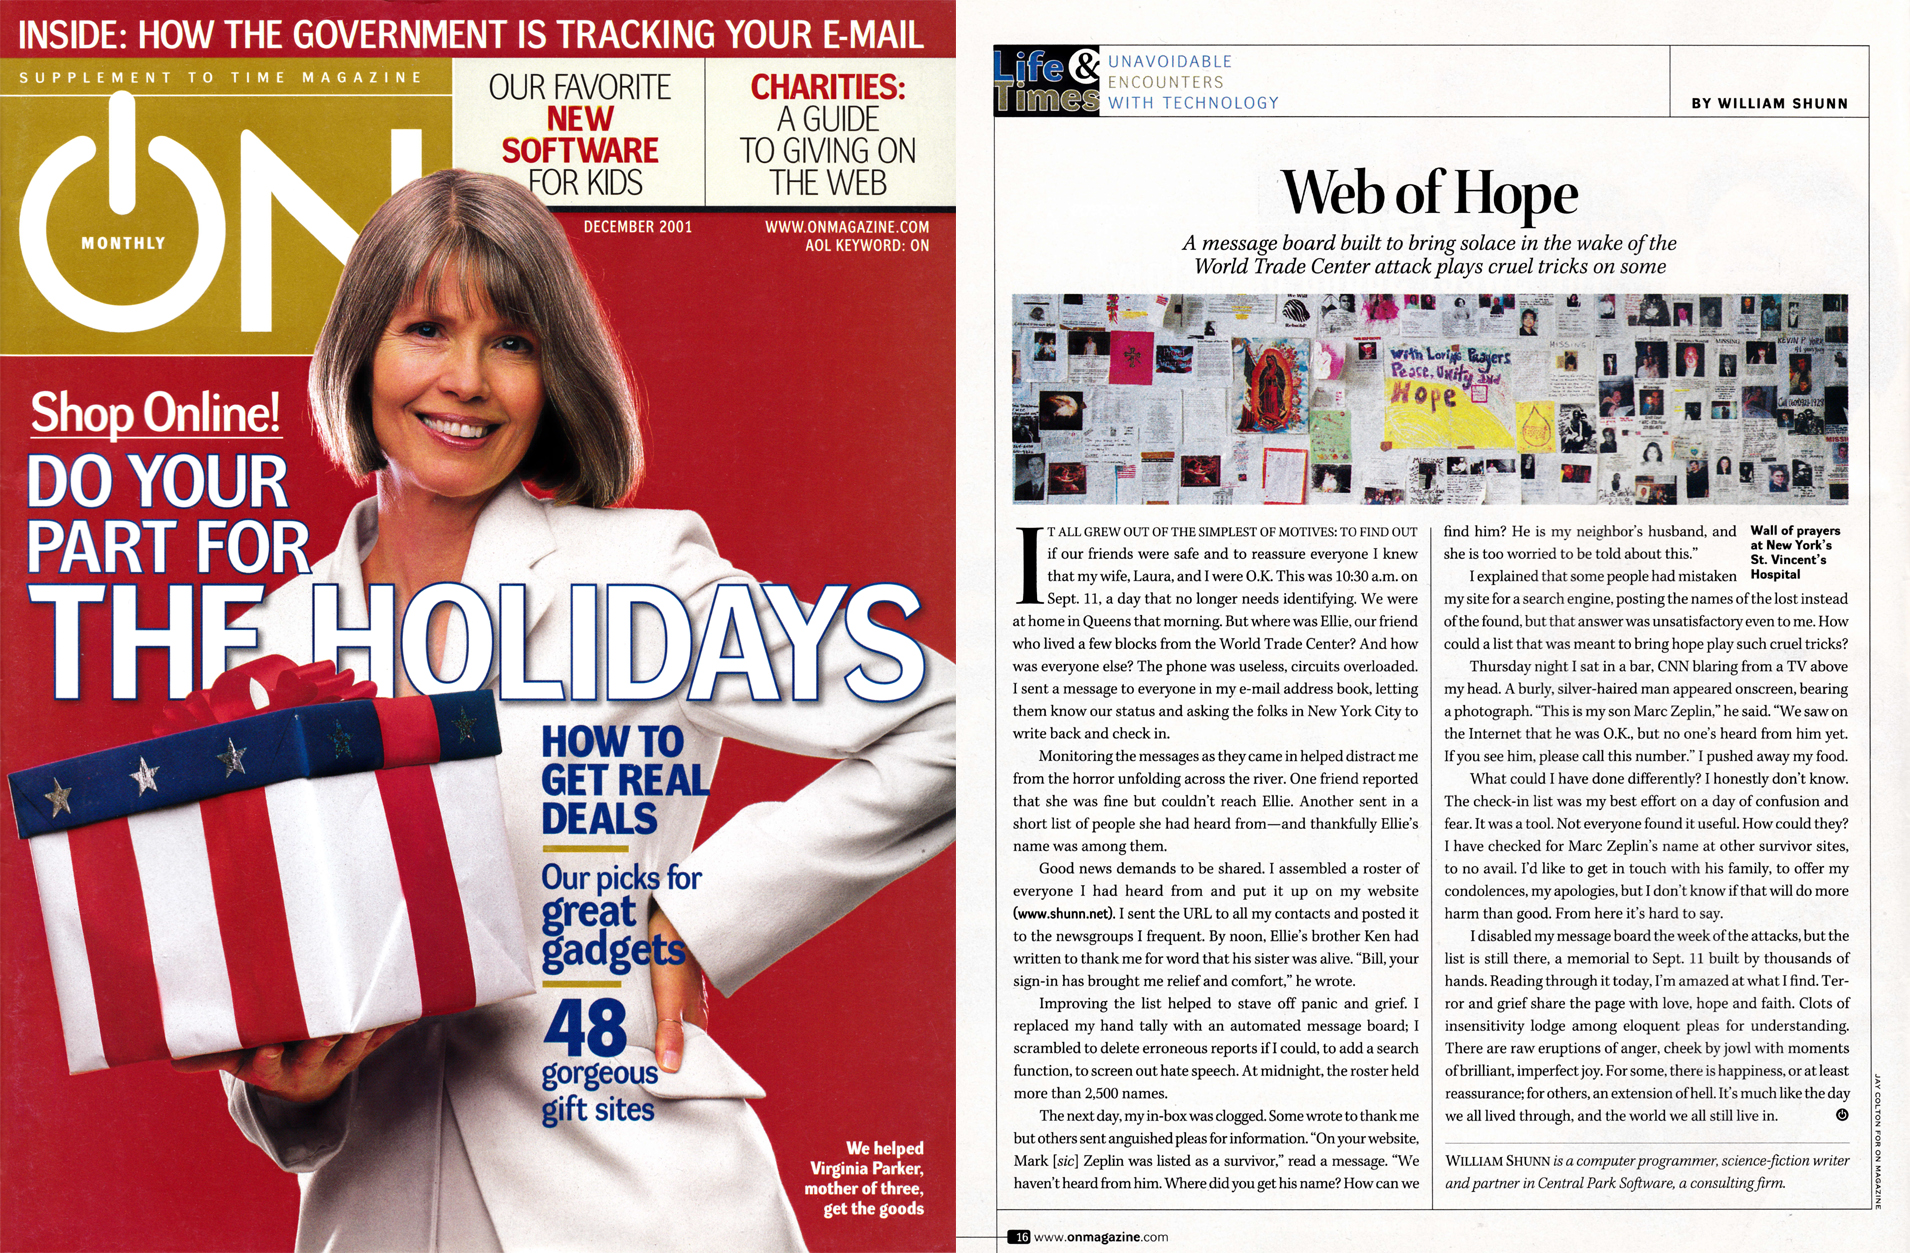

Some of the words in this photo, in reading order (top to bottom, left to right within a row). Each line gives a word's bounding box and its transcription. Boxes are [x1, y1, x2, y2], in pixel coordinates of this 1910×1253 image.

[20, 20, 125, 49] INSIDE:
[140, 20, 214, 49] HOW
[224, 20, 282, 48] THE
[294, 20, 507, 48] GOVERNMENT
[519, 20, 545, 48] IS
[557, 20, 714, 48] TRACKING
[725, 20, 812, 48] YOUR
[825, 20, 924, 48] E-MAIL
[994, 49, 1064, 83] Life
[1074, 51, 1100, 79] &
[1109, 55, 1231, 68] UNAVOIDABLE
[20, 72, 170, 83] SUPPLEMENT
[189, 72, 212, 83] TO
[231, 72, 283, 83] TIME
[303, 72, 420, 83] MAGAZINE
[490, 73, 545, 100] OUR
[555, 73, 671, 100] FAVORITE
[751, 73, 905, 100] CHARITIES:
[1109, 76, 1222, 88] ENCOUNTERS
[994, 80, 1100, 111] Times
[1108, 97, 1152, 109] WITH
[1163, 96, 1278, 109] TECHNOLOGY
[1693, 98, 1711, 108] BY
[1718, 98, 1784, 108] WILLIAM
[1793, 98, 1847, 109] SHUNN
[548, 106, 614, 131] NEW
[777, 105, 795, 131] A
[804, 105, 879, 132] GUIDE
[502, 137, 658, 163] SOFTWARE
[740, 137, 774, 163] TO
[784, 137, 868, 164] GIVING
[878, 137, 915, 164] ON
[530, 169, 578, 195] FOR
[588, 169, 643, 195] KIDS
[769, 169, 818, 195] THE
[827, 169, 887, 195] WEB
[1280, 168, 1385, 214] Web
[1396, 167, 1447, 214] of
[1455, 170, 1578, 228] Hope
[18, 89, 422, 332] ON
[585, 220, 653, 232] DECEMBER
[660, 220, 691, 232] 2001
[766, 221, 928, 233] WWW.ONMAGAZINE.COM
[82, 237, 165, 249] MONTHLY
[806, 239, 831, 251] AOL
[837, 239, 904, 251] KEYWORD:
[911, 239, 928, 251] ON
[1182, 235, 1196, 250] A
[1203, 239, 1277, 256] message
[1283, 234, 1336, 250] board
[1341, 234, 1381, 250] built
[1387, 237, 1403, 250] to
[1409, 234, 1456, 256] bring
[1460, 234, 1515, 250] solace
[1522, 235, 1538, 250] in
[1544, 234, 1571, 250] the
[1578, 234, 1622, 250] wake
[1628, 234, 1646, 255] of
[1647, 234, 1676, 250] the
[1196, 258, 1249, 274] World
[1255, 258, 1305, 274] Trade
[1312, 258, 1370, 274] Center
[1375, 258, 1431, 274] attack
[1435, 258, 1483, 278] plays
[1489, 258, 1533, 273] cruel
[1539, 258, 1588, 273] tricks
[1594, 263, 1614, 273] on
[1621, 263, 1666, 273] some
[1391, 381, 1456, 414] Hope
[32, 390, 134, 443] Shop
[144, 390, 279, 432] Online!
[27, 453, 113, 508] DO
[126, 453, 289, 508] YOUR
[1751, 525, 1777, 535] Wall
[1782, 525, 1794, 535] of
[1797, 528, 1840, 540] prayers
[27, 520, 179, 573] PART
[198, 519, 313, 575] FOR
[1751, 541, 1763, 550] at
[1767, 540, 1792, 550] New
[1751, 554, 1767, 564] St.
[1751, 569, 1800, 582] Hospital
[27, 583, 267, 702] THE
[311, 582, 926, 703] HOLIDAYS
[543, 725, 630, 757] HOW
[638, 725, 684, 758] TO
[1013, 728, 1046, 739] write
[1050, 727, 1080, 739] back
[1085, 727, 1108, 739] and
[1113, 727, 1150, 739] check
[1155, 728, 1169, 739] in.
[542, 763, 609, 796] GET
[620, 764, 710, 796] REAL
[543, 802, 657, 835] DEALS
[542, 863, 590, 890] Our
[597, 863, 660, 898] picks
[667, 863, 702, 889] for
[542, 895, 636, 930] great
[1445, 907, 1478, 919] harm
[1484, 907, 1512, 919] than
[1517, 907, 1551, 922] good.
[1556, 908, 1590, 919] From
[1595, 907, 1622, 919] here
[1649, 907, 1678, 919] hard
[1683, 909, 1695, 919] to
[1700, 911, 1723, 922] say.
[543, 932, 685, 975] gadgets
[544, 998, 627, 1057] 48
[542, 1063, 658, 1091] gorgeous
[1052, 1087, 1081, 1098] than
[1086, 1088, 1118, 1100] 2,500
[1123, 1091, 1167, 1099] names.
[542, 1095, 587, 1128] gift
[596, 1096, 654, 1121] sites
[847, 1141, 869, 1154] We
[874, 1141, 923, 1158] helped
[1875, 1150, 1881, 1162] ON
[811, 1161, 867, 1178] Virginia
[873, 1161, 923, 1175] Parker,
[1445, 1155, 1503, 1166] WILLIAM
[1506, 1155, 1550, 1166] SHUNN
[1554, 1155, 1563, 1166] is
[1566, 1158, 1574, 1166] a
[1577, 1156, 1636, 1170] computer
[1637, 1158, 1718, 1170] programmer,
[1722, 1154, 1809, 1169] science-fiction
[1813, 1155, 1850, 1166] writer
[805, 1181, 858, 1194] mother
[862, 1181, 877, 1194] of
[881, 1181, 923, 1195] three,
[1446, 1177, 1470, 1189] and
[1471, 1179, 1520, 1192] partner
[1523, 1178, 1535, 1188] in
[1538, 1177, 1584, 1189] Central
[1587, 1177, 1615, 1188] Park
[1619, 1177, 1675, 1192] Software,
[1679, 1180, 1687, 1188] a
[1690, 1176, 1754, 1192] consulting
[1754, 1176, 1785, 1192] firm.
[824, 1203, 847, 1218] get
[851, 1201, 875, 1214] the
[880, 1201, 924, 1218] goods
[1017, 1233, 1028, 1241] 16
[1034, 1232, 1168, 1244] www.onmagazine.com
